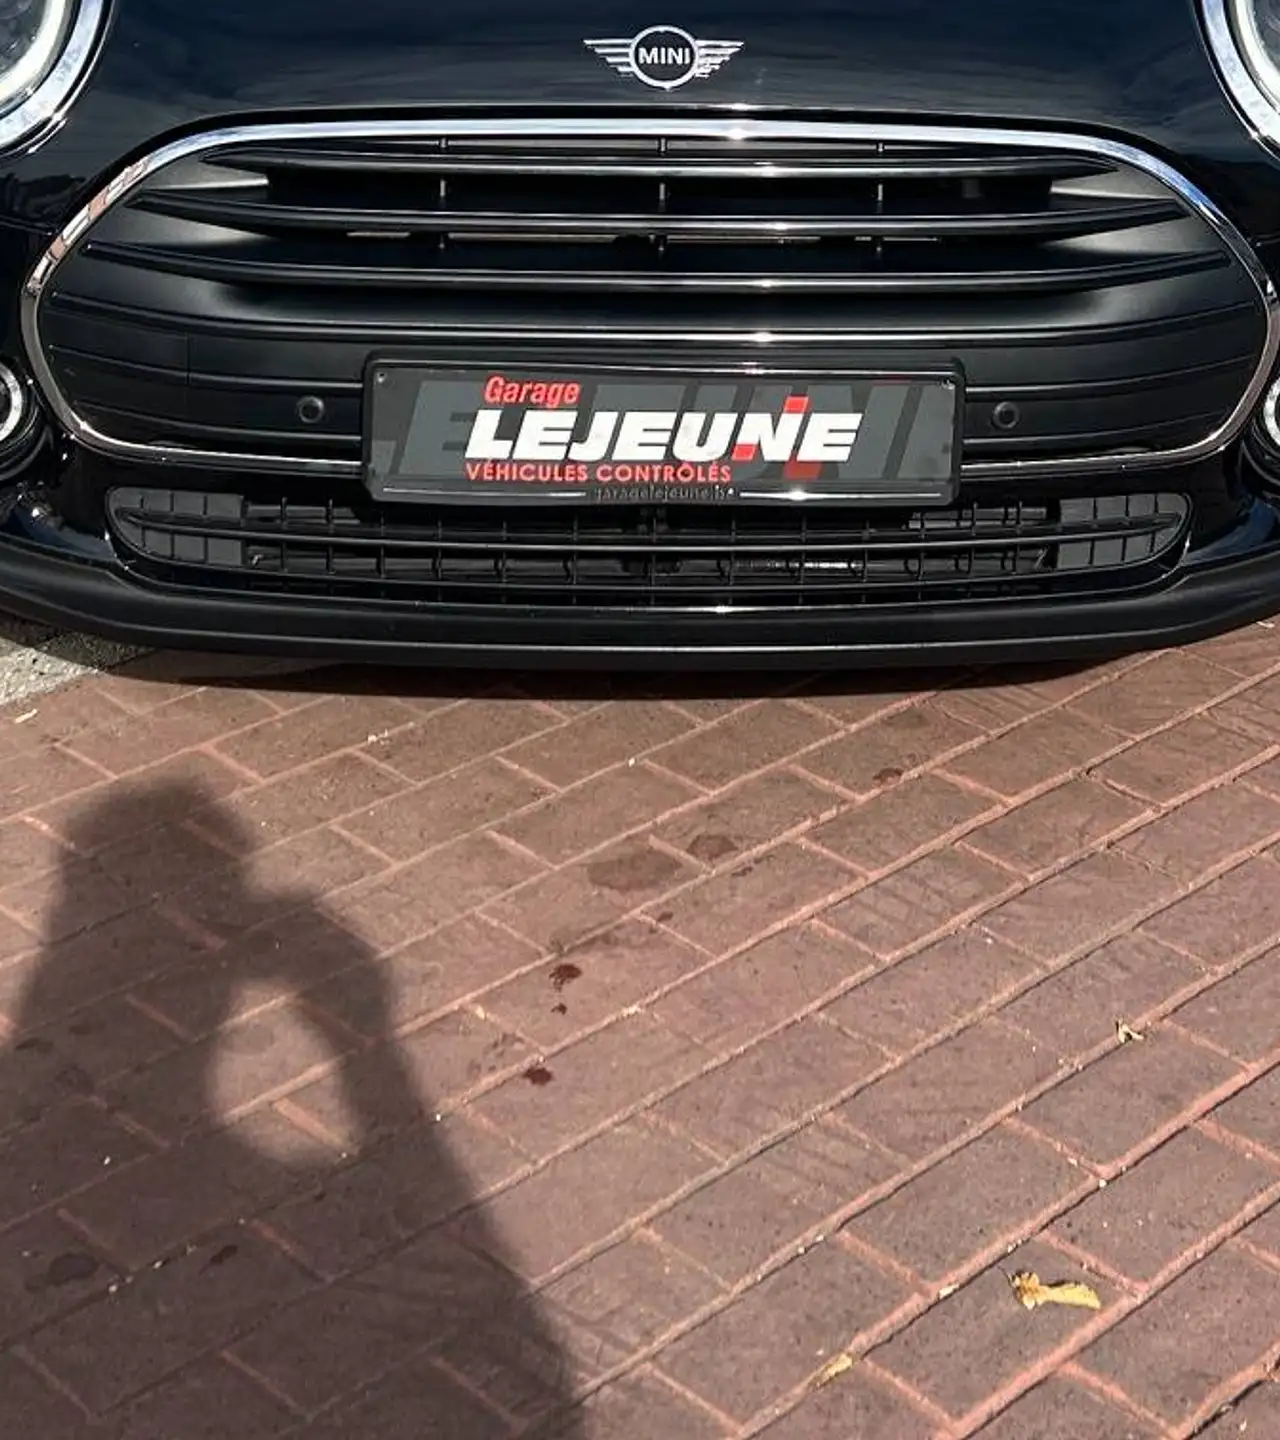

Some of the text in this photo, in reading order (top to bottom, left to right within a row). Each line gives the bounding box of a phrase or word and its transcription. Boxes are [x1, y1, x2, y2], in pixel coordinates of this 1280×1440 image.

[637, 47, 692, 65] MINI
[484, 375, 581, 408] Garage
[464, 398, 862, 463] LEJEUNE
[465, 460, 589, 483] VÉHICULES
